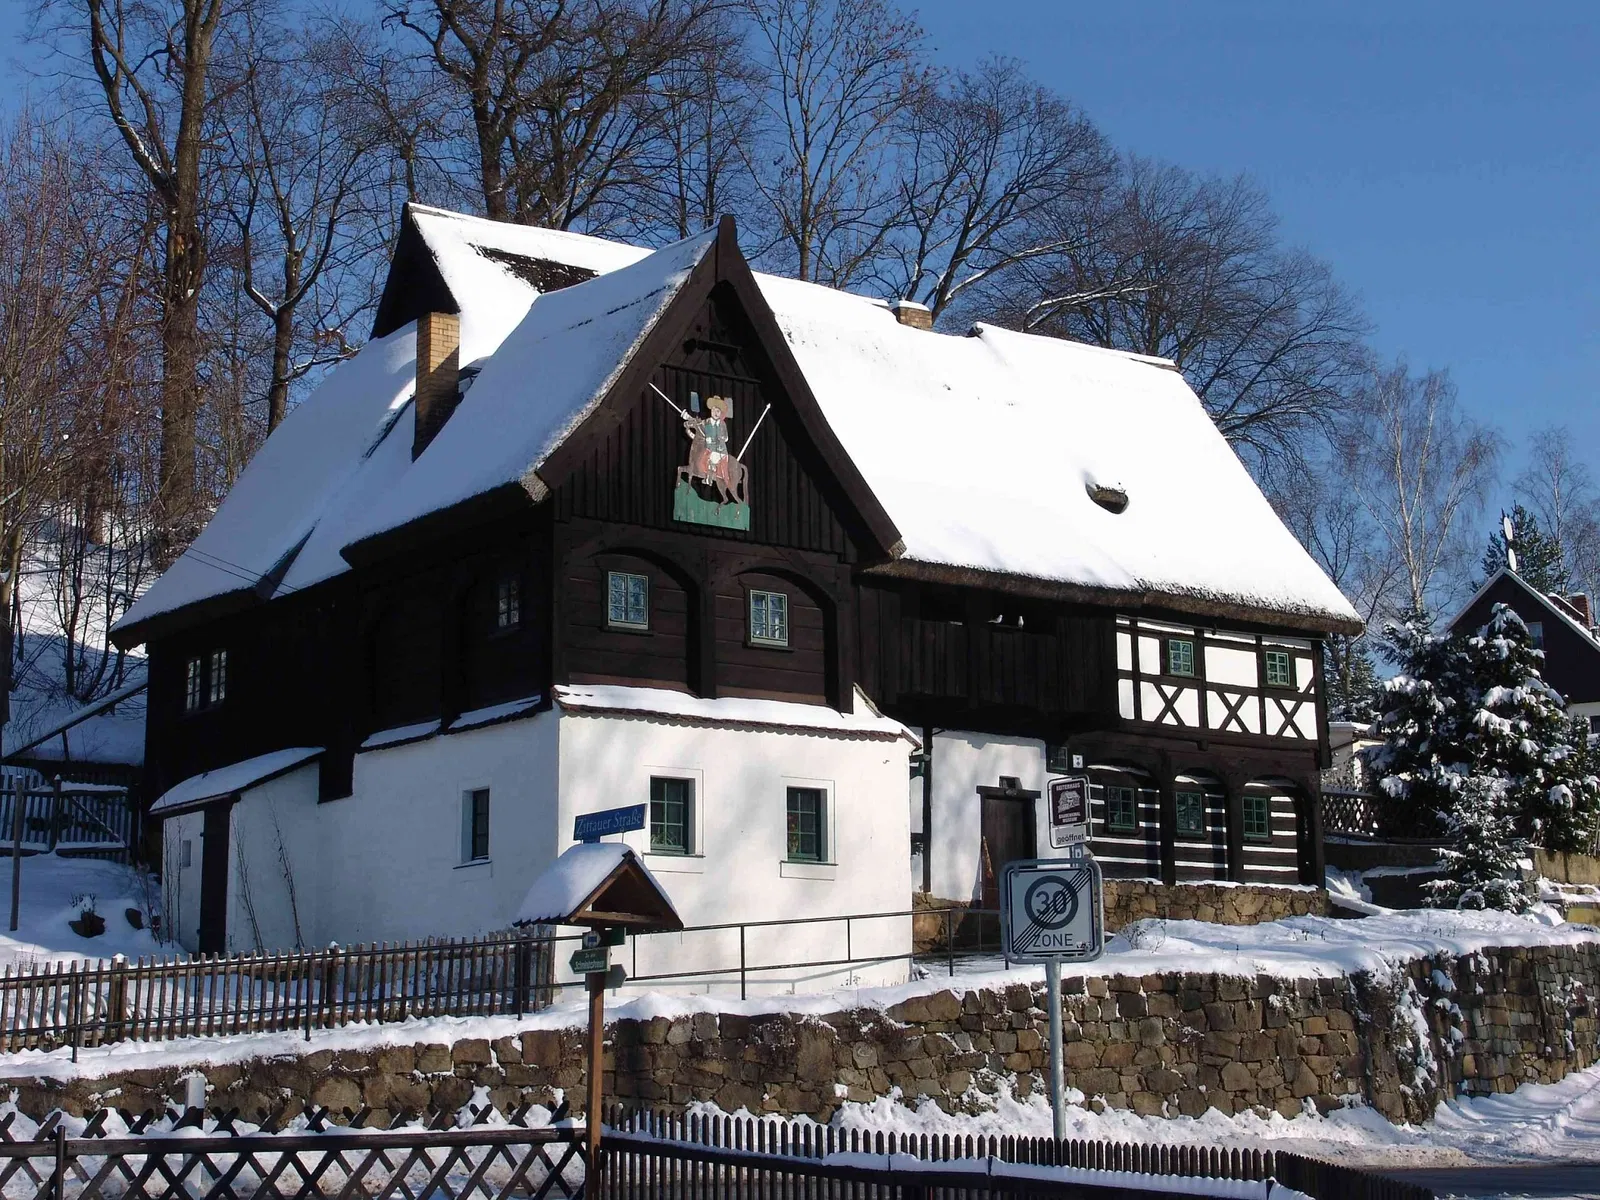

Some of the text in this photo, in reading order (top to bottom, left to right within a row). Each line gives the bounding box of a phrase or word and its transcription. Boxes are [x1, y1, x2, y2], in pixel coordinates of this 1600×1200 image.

[576, 809, 641, 835] Zittauer Straße
[1056, 833, 1084, 844] geöffnet
[1036, 890, 1066, 914] 30
[1032, 933, 1073, 948] ZONE
